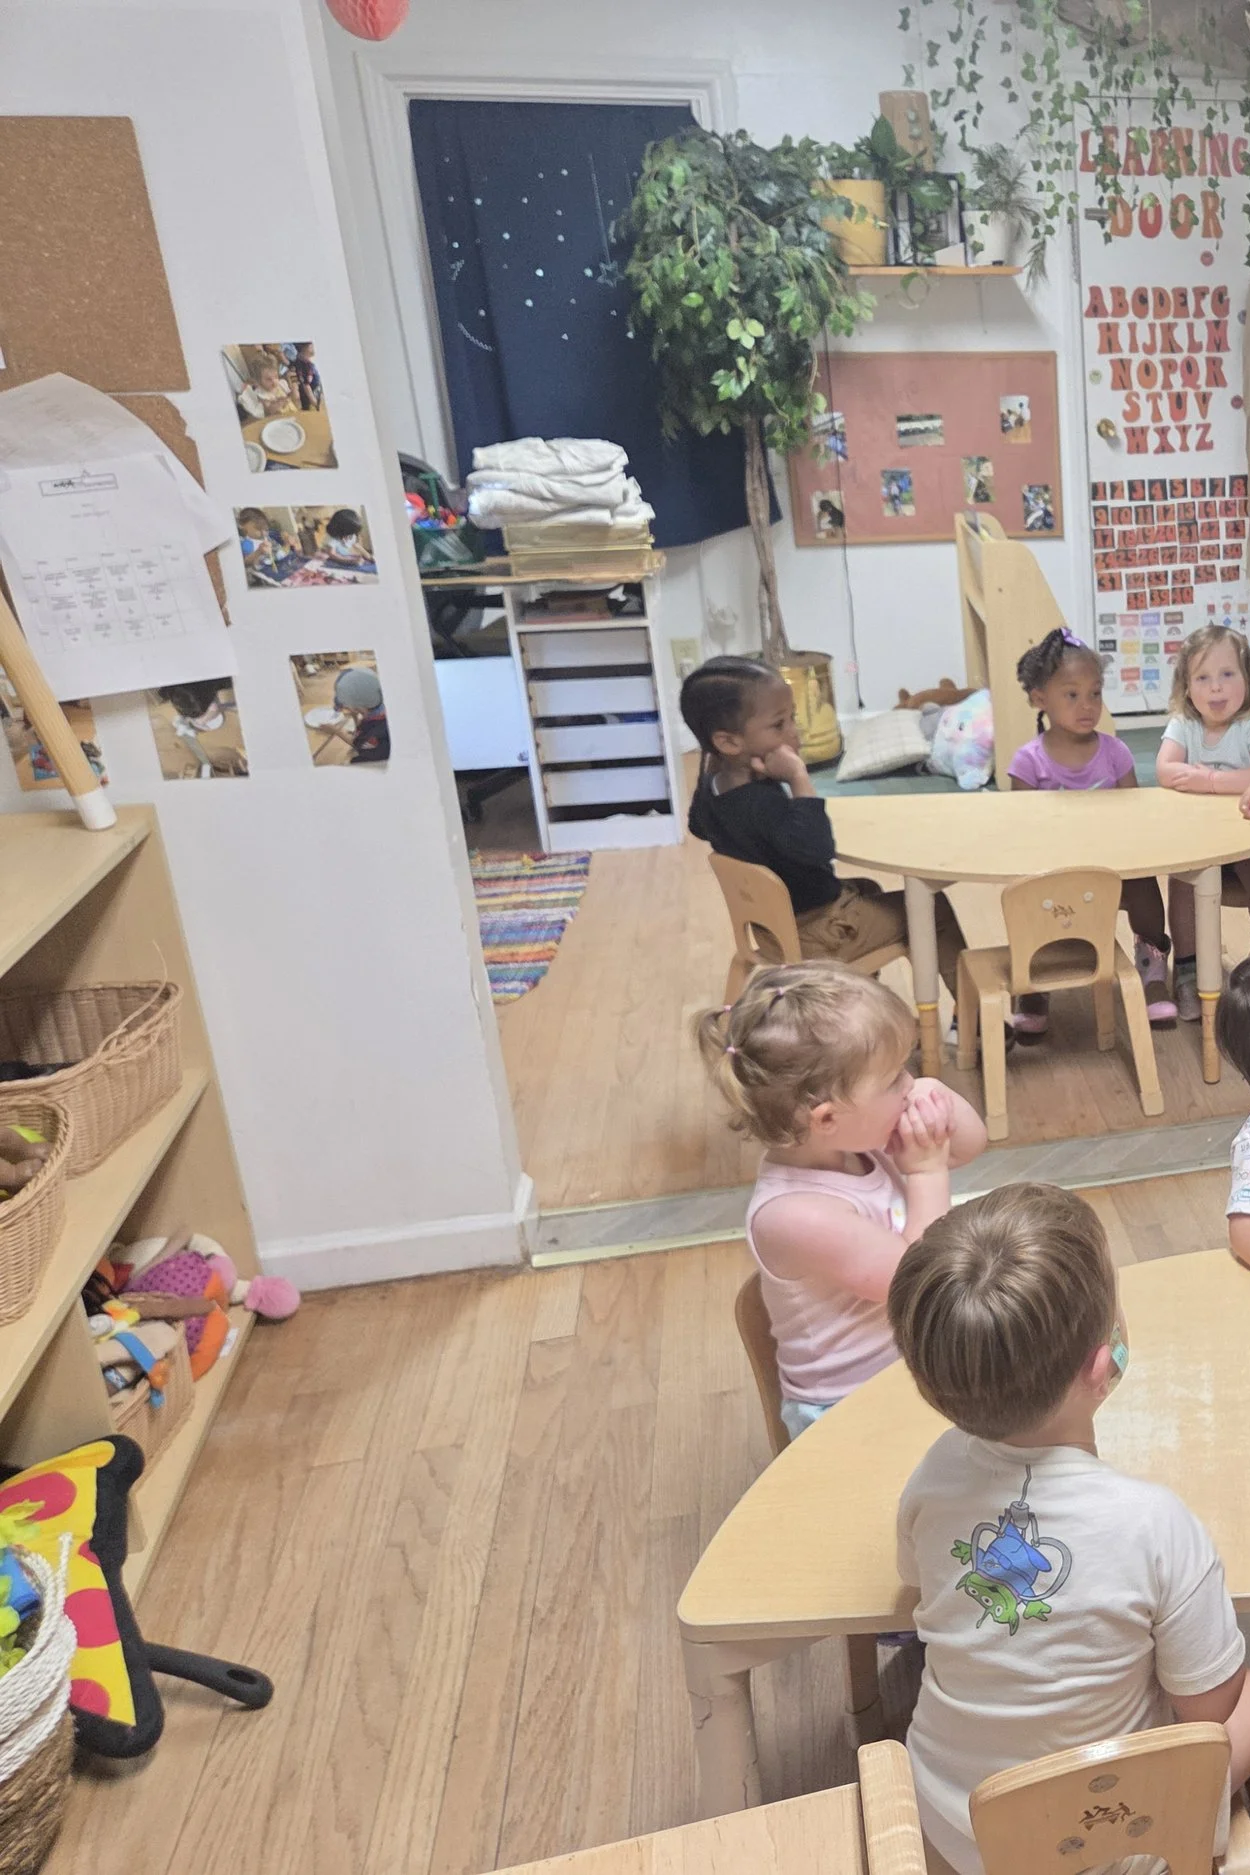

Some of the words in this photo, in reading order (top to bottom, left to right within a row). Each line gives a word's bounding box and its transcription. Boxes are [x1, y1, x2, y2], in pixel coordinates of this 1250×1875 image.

[1079, 126, 1250, 177] LEARNING
[1107, 191, 1223, 239] DOOR
[1096, 481, 1106, 500] 1
[1110, 480, 1124, 499] 2
[1131, 480, 1144, 499] 3
[1151, 482, 1164, 500] 4
[1172, 479, 1184, 497] 5
[1191, 478, 1204, 497] 6
[1211, 478, 1223, 497] 7
[1231, 478, 1245, 497] 8
[1095, 507, 1108, 525] 9
[1111, 506, 1132, 525] 10
[1136, 506, 1153, 525] 11
[1157, 504, 1174, 522] 12
[1178, 502, 1194, 520] 13
[1198, 501, 1216, 518] 14
[1219, 500, 1237, 517] 15
[1239, 500, 1248, 516] 1
